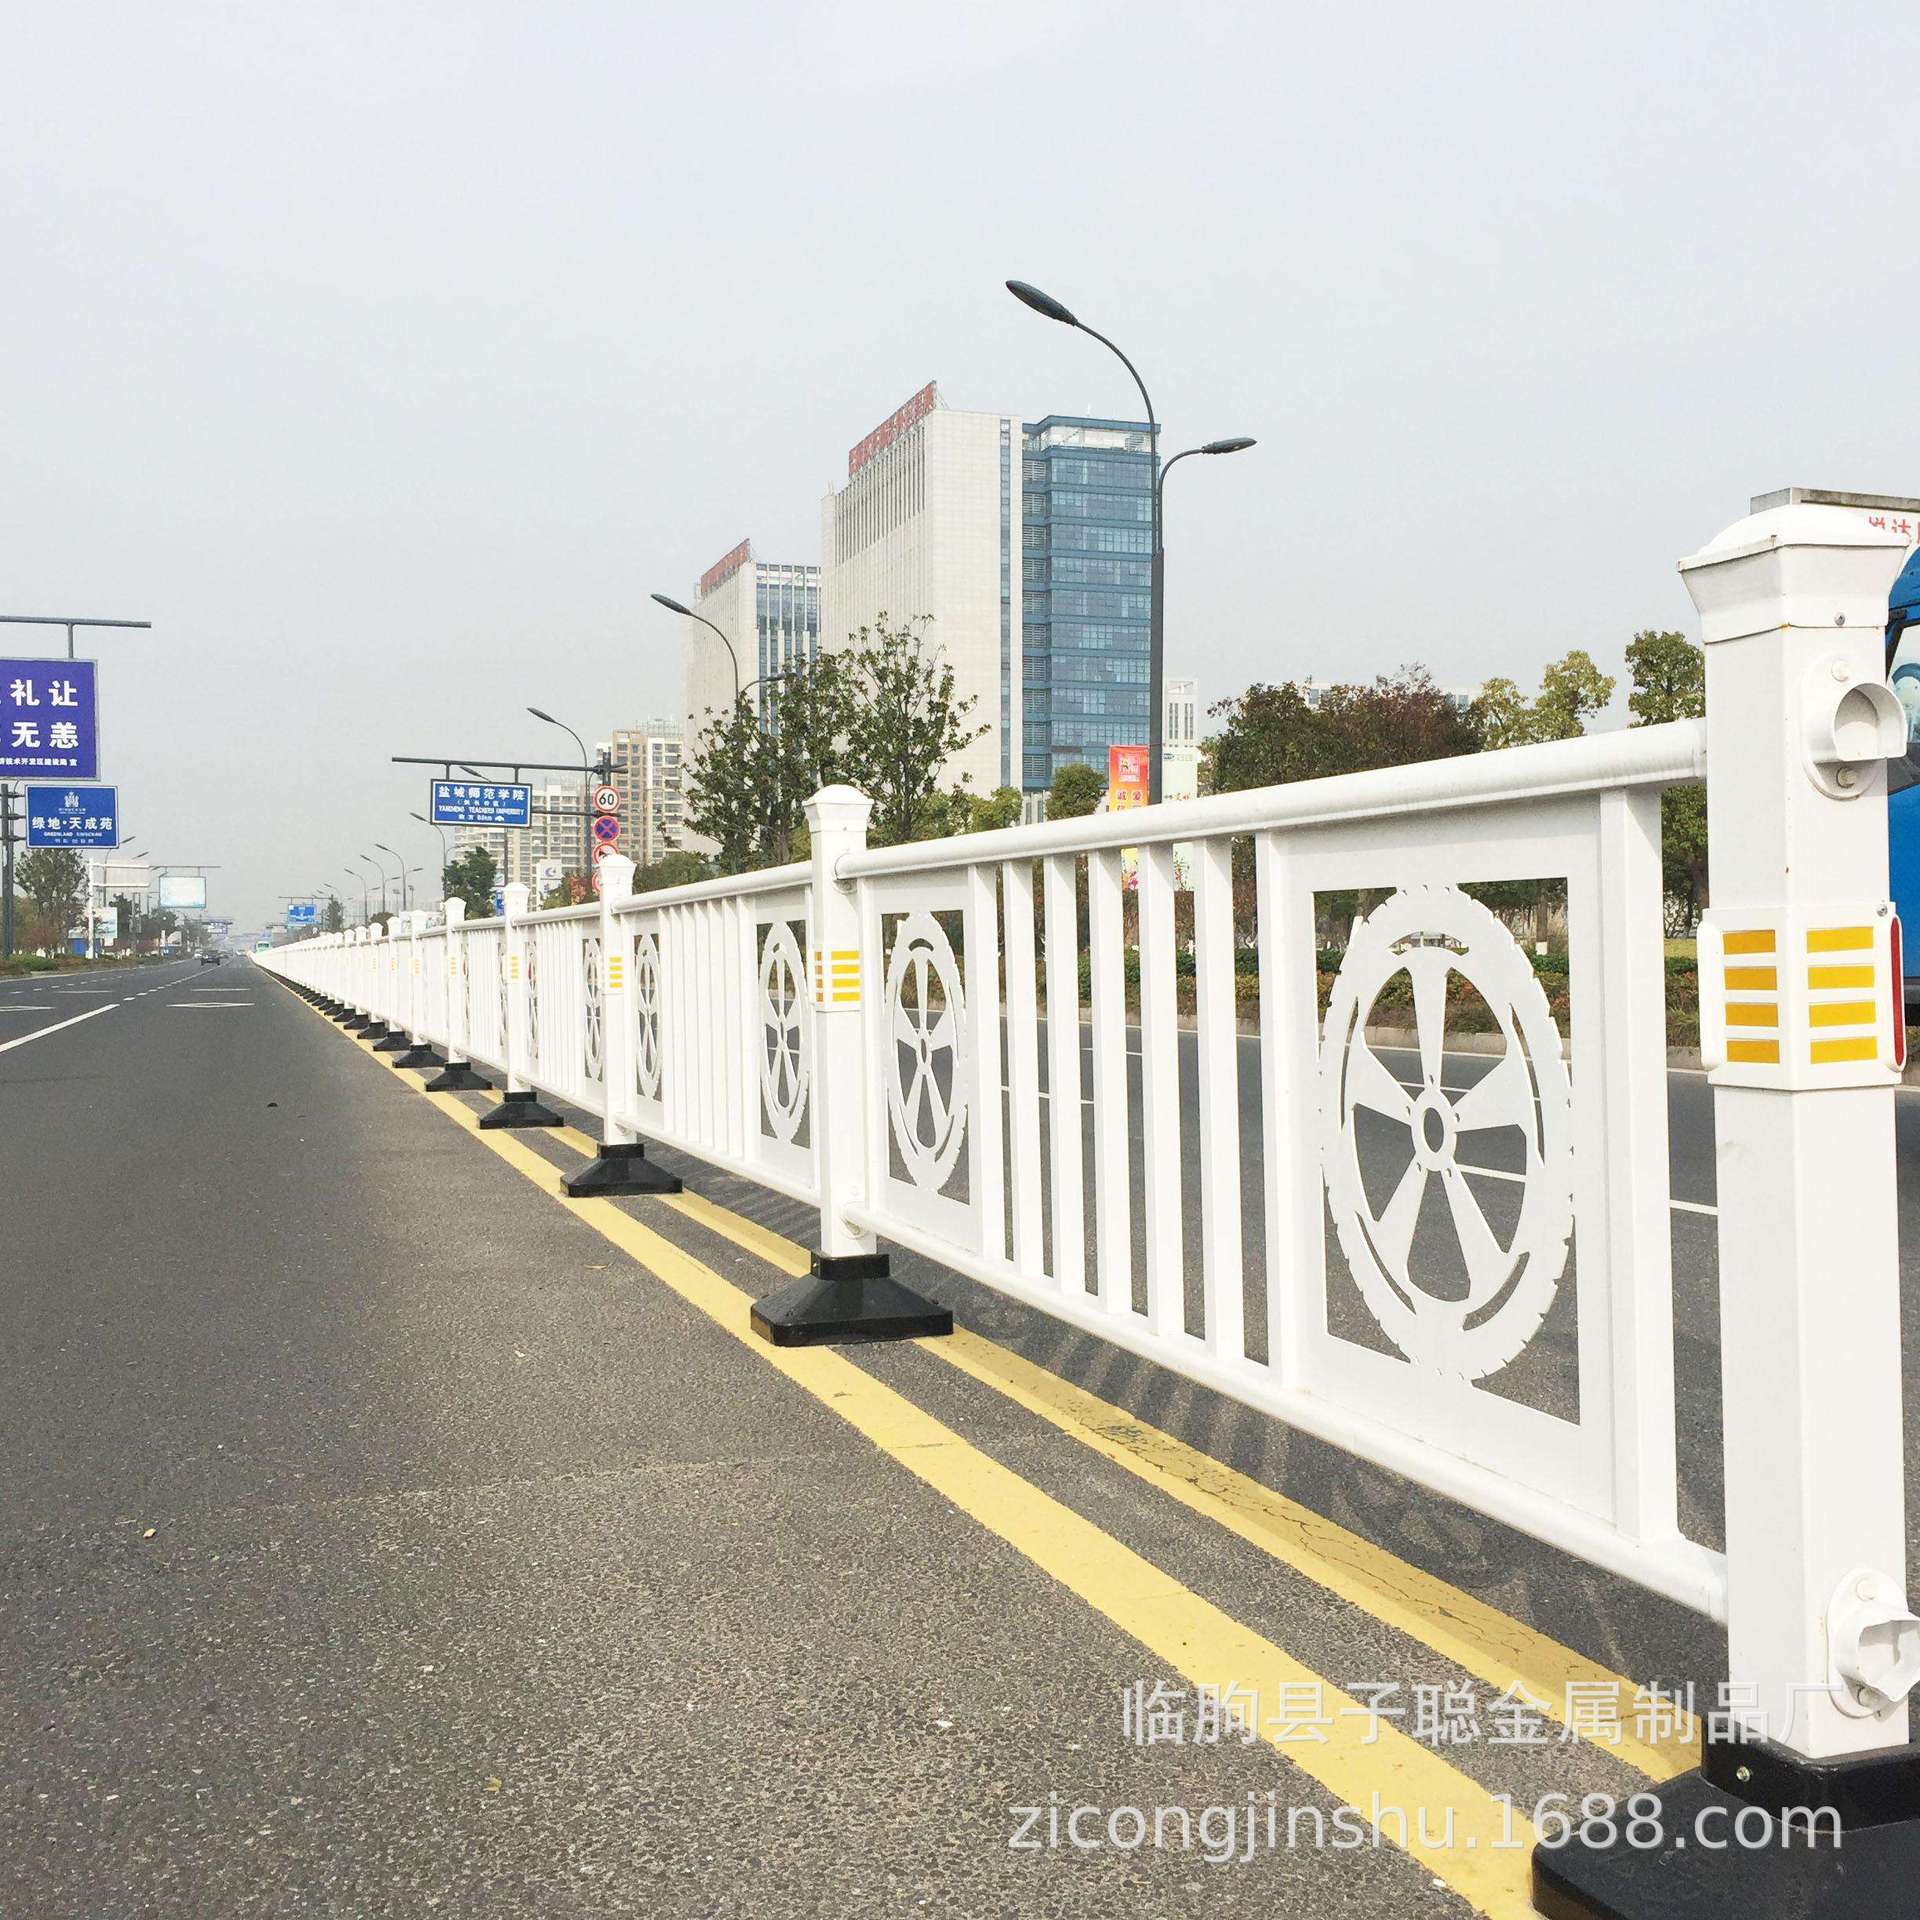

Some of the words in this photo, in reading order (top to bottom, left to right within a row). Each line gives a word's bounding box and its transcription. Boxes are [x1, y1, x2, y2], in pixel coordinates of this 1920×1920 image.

[10, 679, 78, 707] 礼让
[11, 721, 79, 749] 无恙
[438, 786, 525, 800] 盐城师范学院
[599, 793, 614, 805] 60
